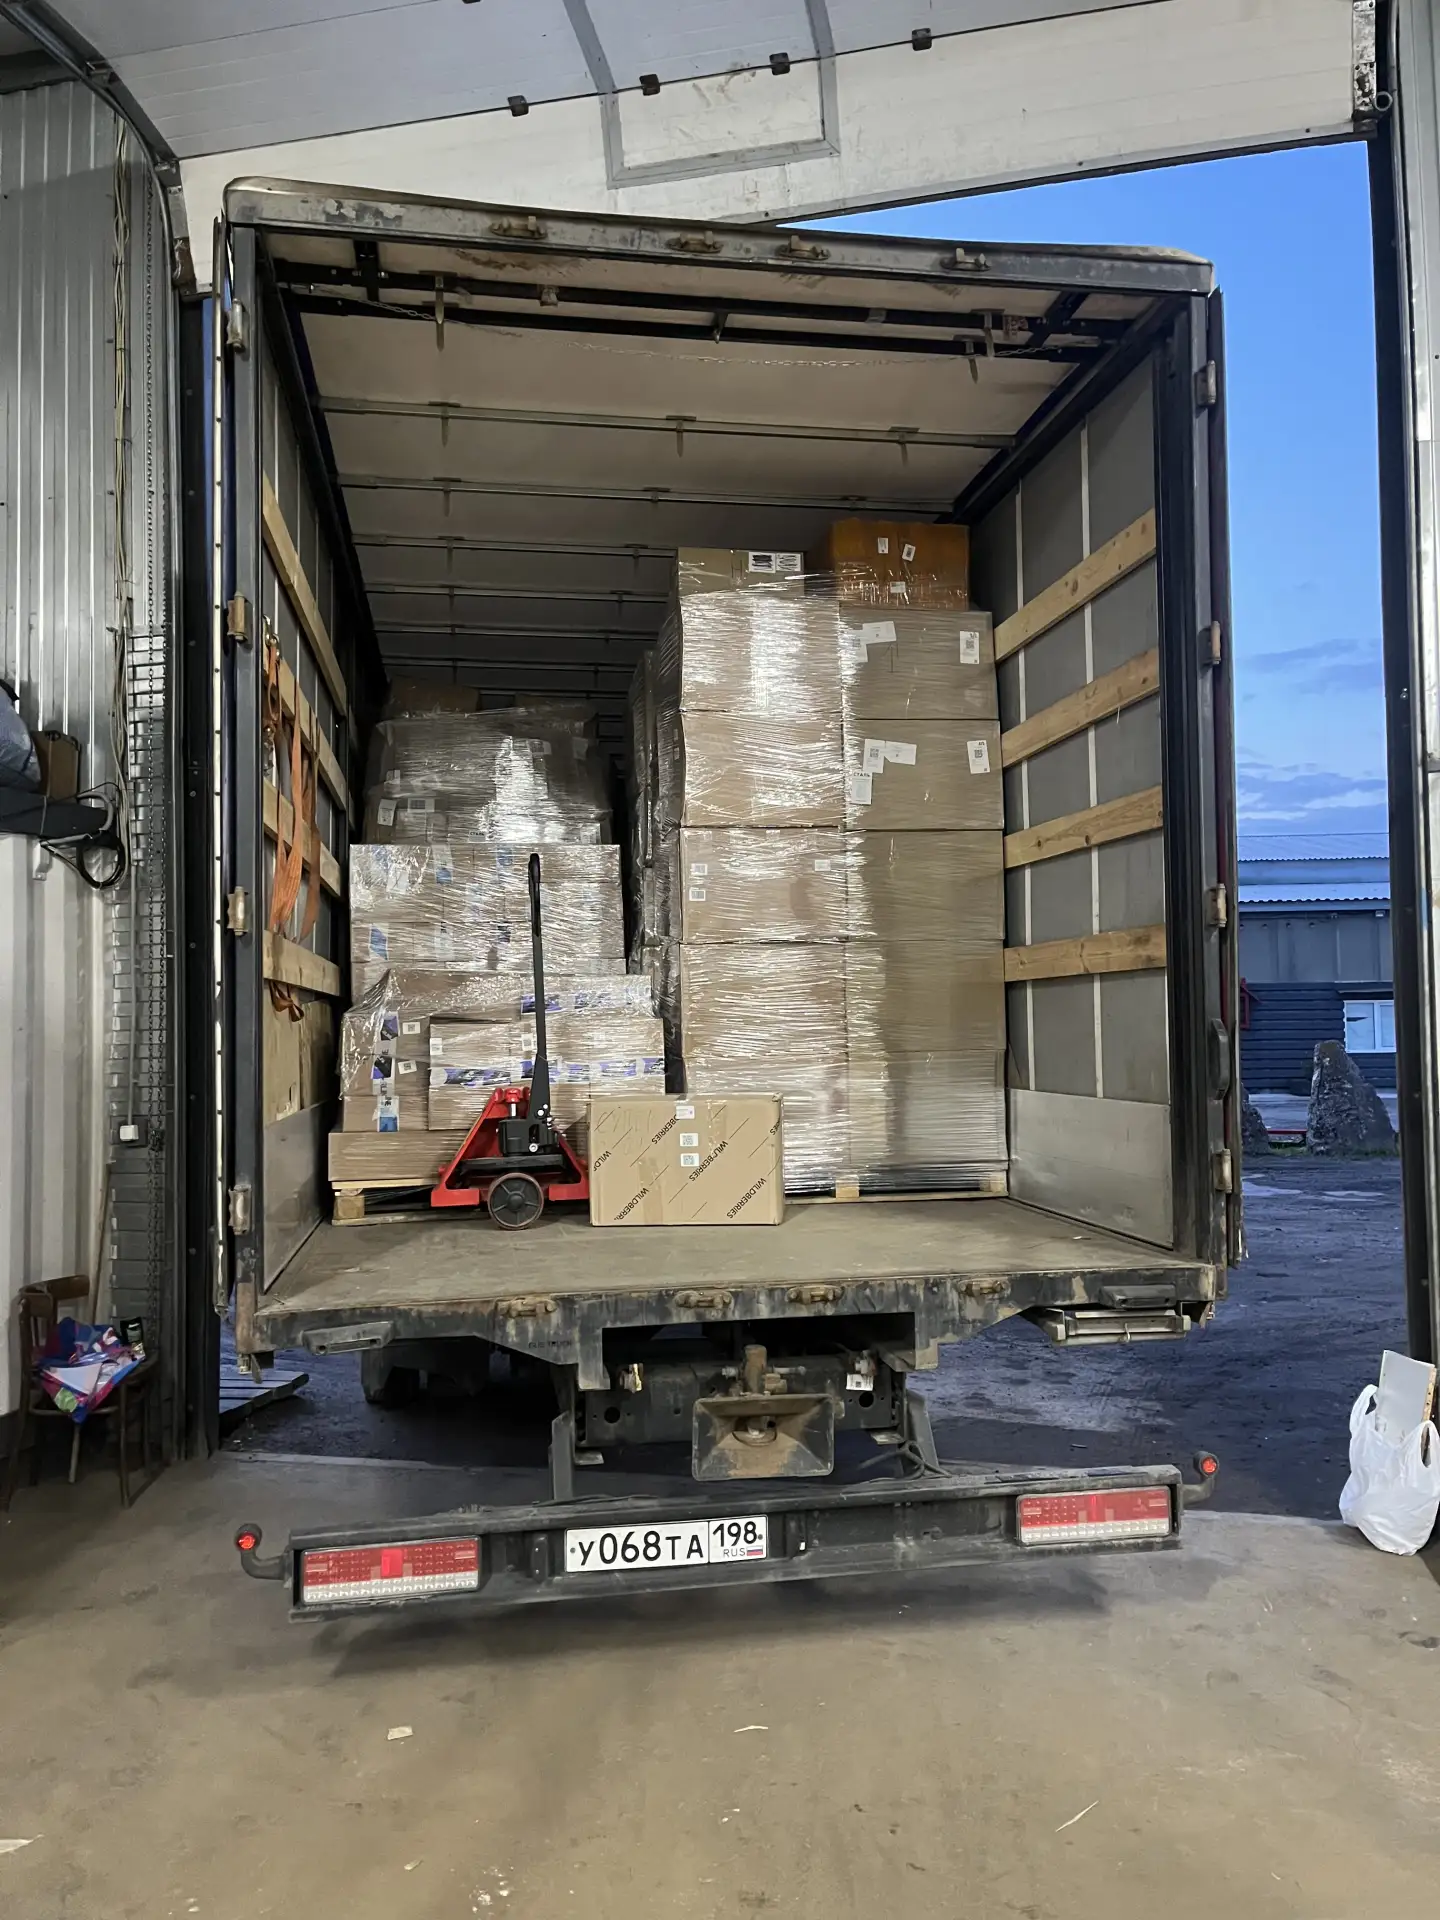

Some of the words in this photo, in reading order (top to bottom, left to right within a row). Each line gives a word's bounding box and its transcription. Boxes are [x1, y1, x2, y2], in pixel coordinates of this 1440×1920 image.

[726, 1177, 767, 1219] WILDBERRIES
[578, 1530, 704, 1566] У068ТА
[712, 1521, 758, 1547] 198
[722, 1547, 746, 1558] RUS
